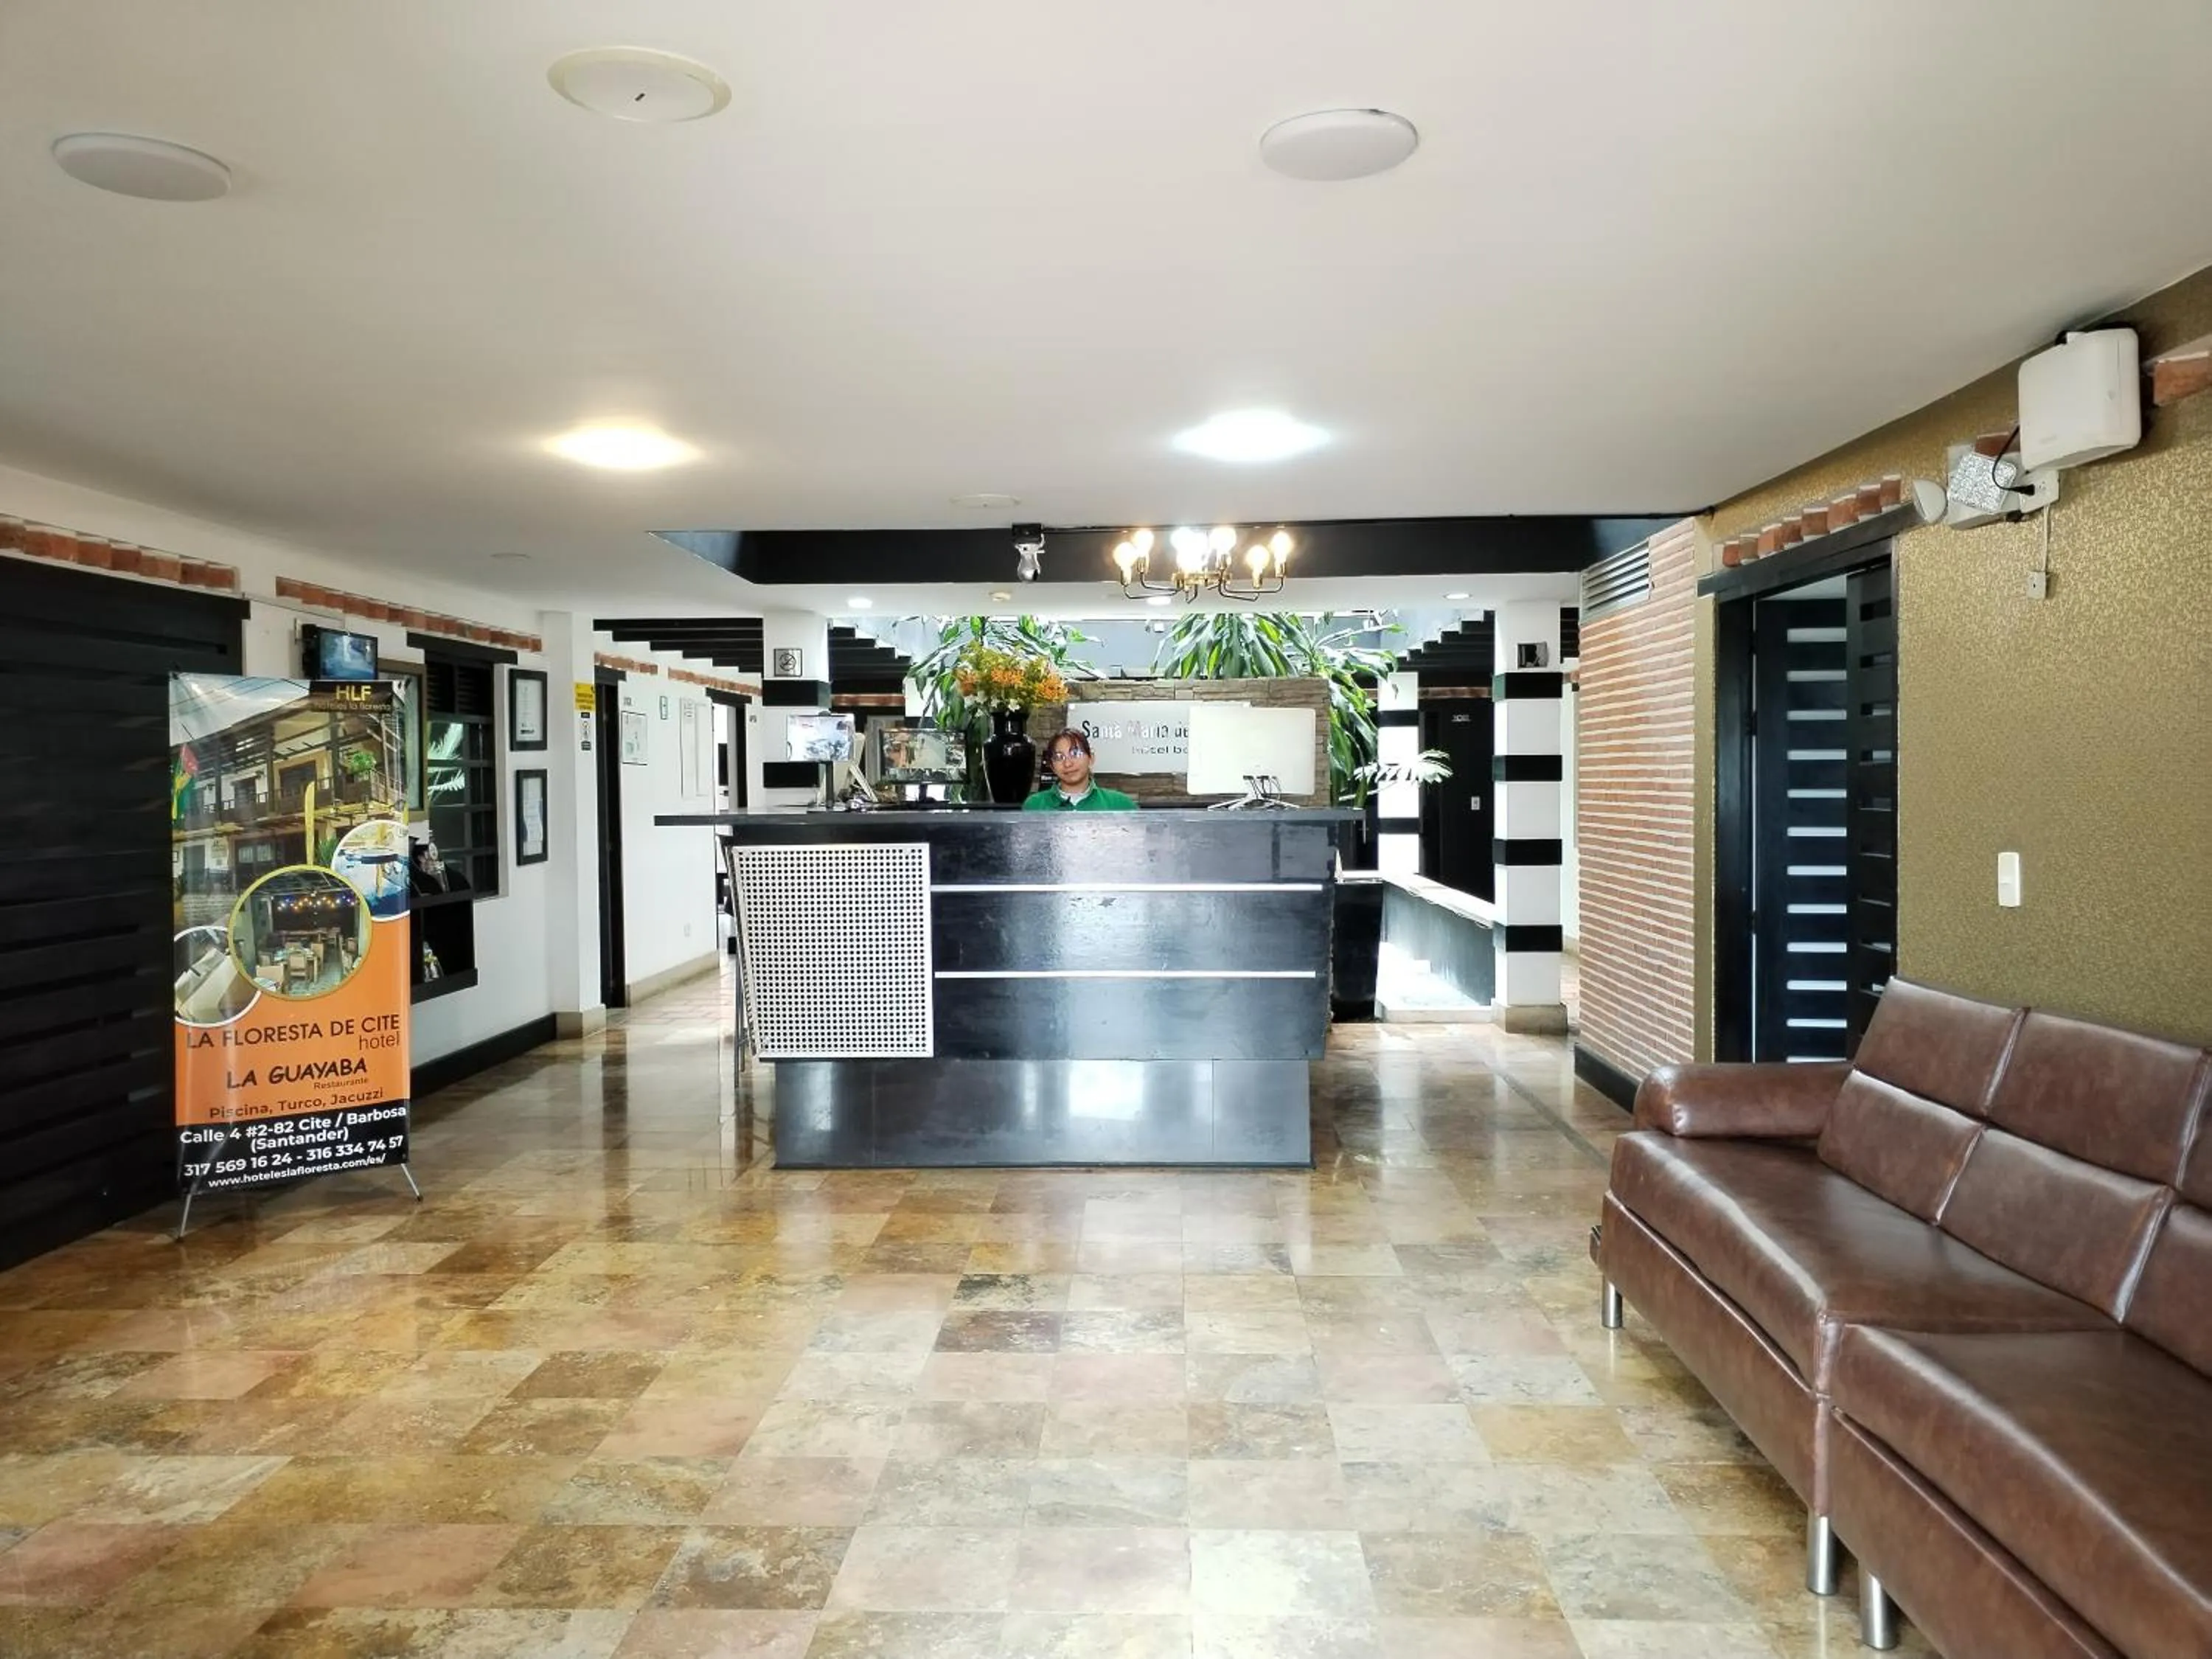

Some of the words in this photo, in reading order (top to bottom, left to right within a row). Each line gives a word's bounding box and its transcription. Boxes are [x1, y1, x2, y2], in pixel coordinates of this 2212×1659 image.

[335, 685, 372, 701] HLF
[187, 1032, 214, 1048] LA
[223, 1023, 323, 1047] FLORESTA
[330, 1019, 355, 1037] DE
[361, 1014, 400, 1033] CITE
[359, 1031, 400, 1050] hotel
[227, 1070, 257, 1089] LA
[268, 1057, 366, 1084] GUAYABA
[313, 1077, 369, 1089] Restaurante
[210, 1105, 273, 1119] Piscina,
[277, 1094, 327, 1111] Turco,
[330, 1087, 383, 1105] Jacuzzi
[180, 1129, 225, 1144] Calle
[229, 1127, 242, 1139] 4
[246, 1121, 294, 1138] #2-82
[299, 1116, 332, 1131] Cite
[334, 1112, 344, 1128] /
[346, 1106, 406, 1125] Barbosa
[251, 1126, 349, 1153] (Santander)
[184, 1163, 211, 1177] 317
[215, 1158, 247, 1174] 569
[250, 1155, 268, 1169] 16
[271, 1152, 293, 1166] 24
[306, 1147, 332, 1161] 316
[335, 1143, 365, 1157] 334
[367, 1139, 386, 1152] 74
[389, 1135, 403, 1149] 57
[208, 1153, 386, 1188] www.hoteleslafloresta.com/es/
